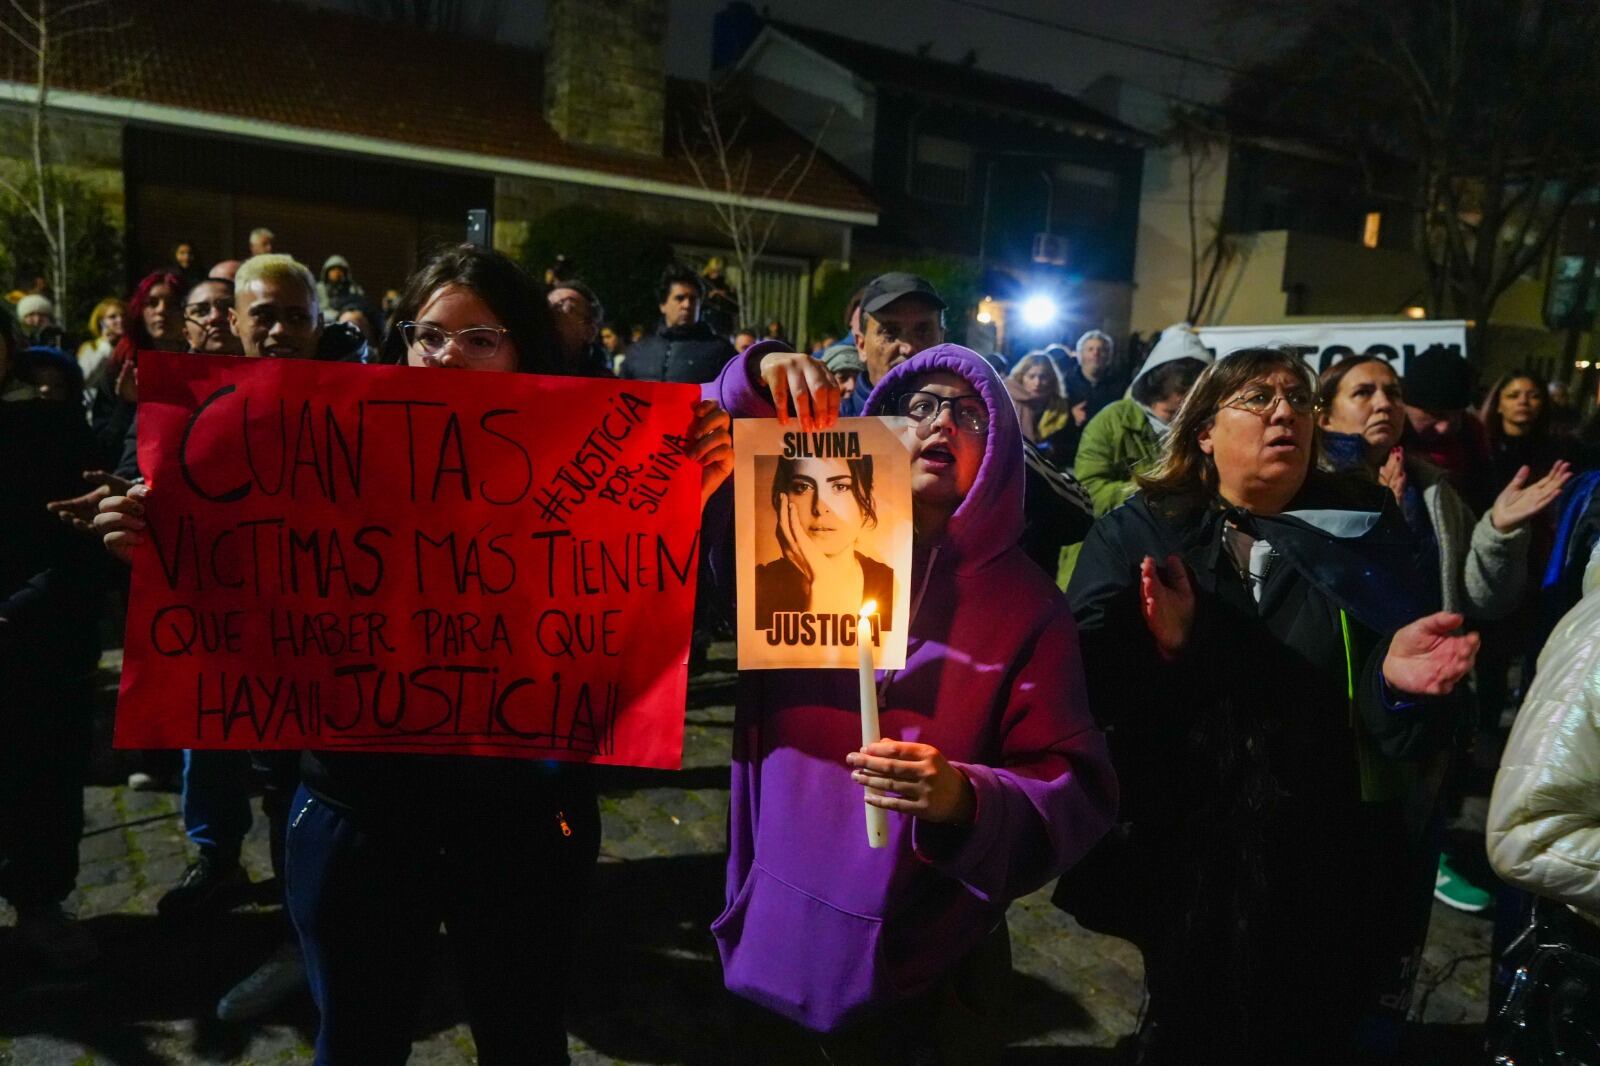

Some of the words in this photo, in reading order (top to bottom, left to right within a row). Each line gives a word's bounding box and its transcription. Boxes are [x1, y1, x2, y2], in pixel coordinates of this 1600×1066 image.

[181, 384, 533, 506] CUANTAS
[533, 391, 652, 524] #JUSTICIA
[629, 432, 689, 515] SILVINA
[783, 431, 862, 458] SILVINA
[599, 463, 644, 505] POR
[415, 523, 516, 596] MÁS
[532, 527, 700, 599] TIENEN
[151, 604, 244, 657] QUE
[270, 608, 396, 657] HABER
[411, 608, 513, 657] PARA
[536, 609, 624, 661] QUE
[766, 612, 881, 648] JUSTICA
